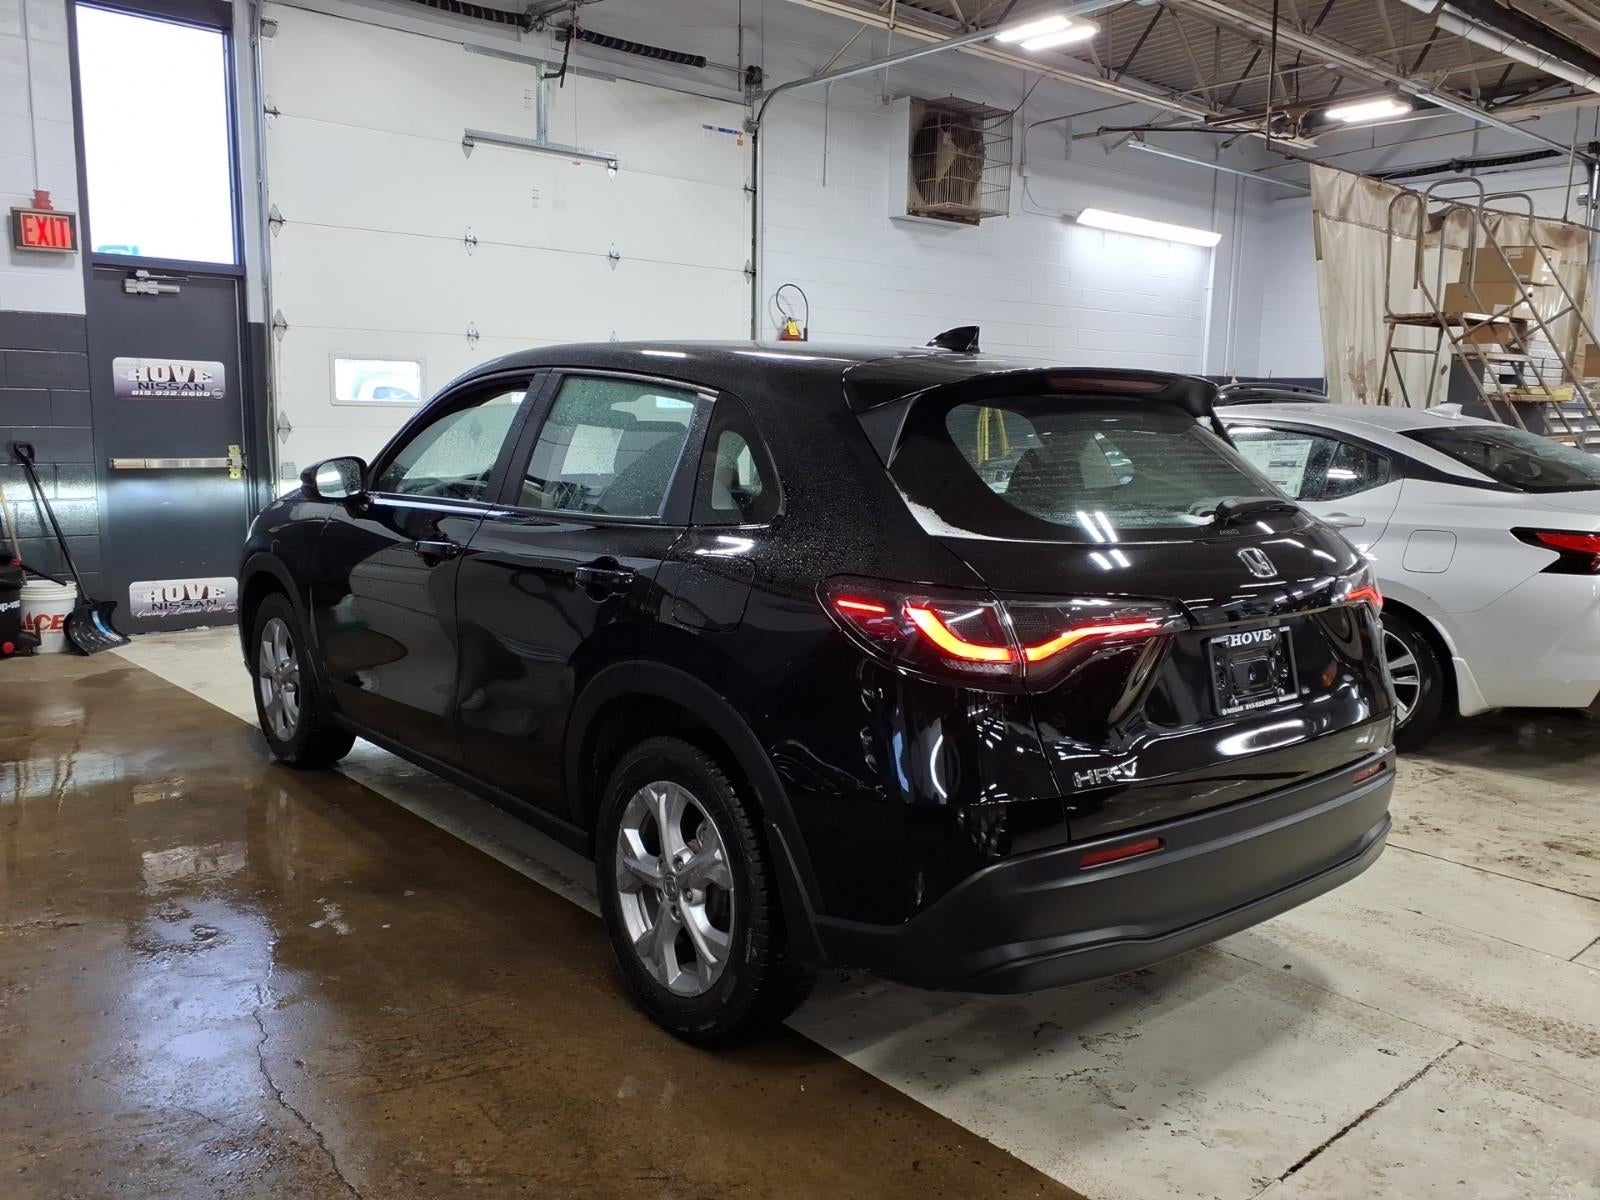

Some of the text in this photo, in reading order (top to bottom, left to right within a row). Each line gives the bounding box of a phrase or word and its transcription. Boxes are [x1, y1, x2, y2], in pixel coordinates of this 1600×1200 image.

[22, 215, 68, 247] EXIT
[128, 364, 213, 382] HOVE
[138, 382, 205, 391] NISSAN
[144, 584, 226, 602] HOVE
[152, 600, 217, 610] NISSAN
[22, 611, 65, 631] ACE
[1229, 629, 1272, 647] HOVE
[1073, 761, 1138, 788] HR-V
